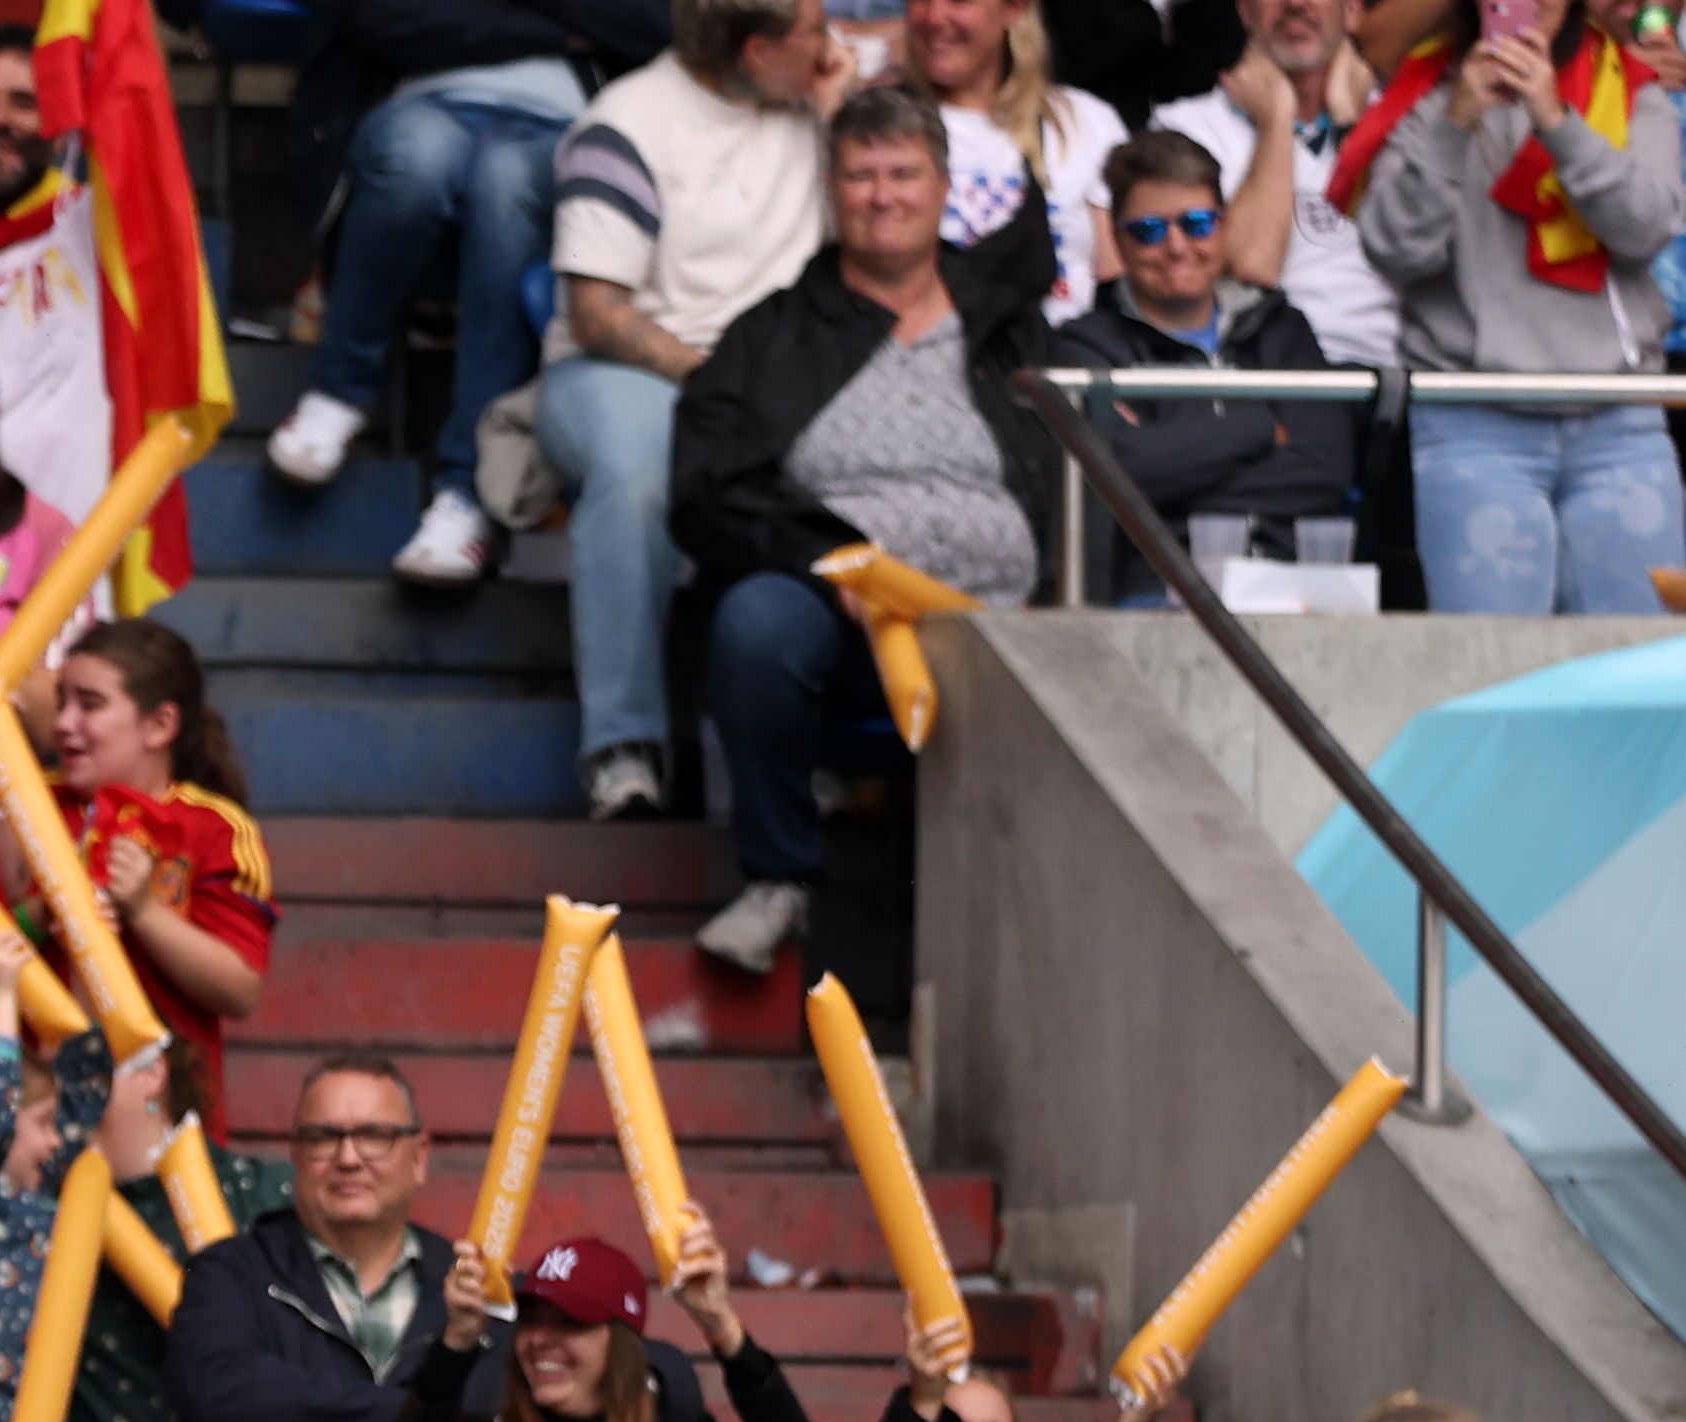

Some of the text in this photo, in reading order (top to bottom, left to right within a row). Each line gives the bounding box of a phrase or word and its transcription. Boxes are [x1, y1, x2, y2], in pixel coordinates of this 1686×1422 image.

[479, 940, 584, 1260] UEFA WOMEN'S EURO 2025
